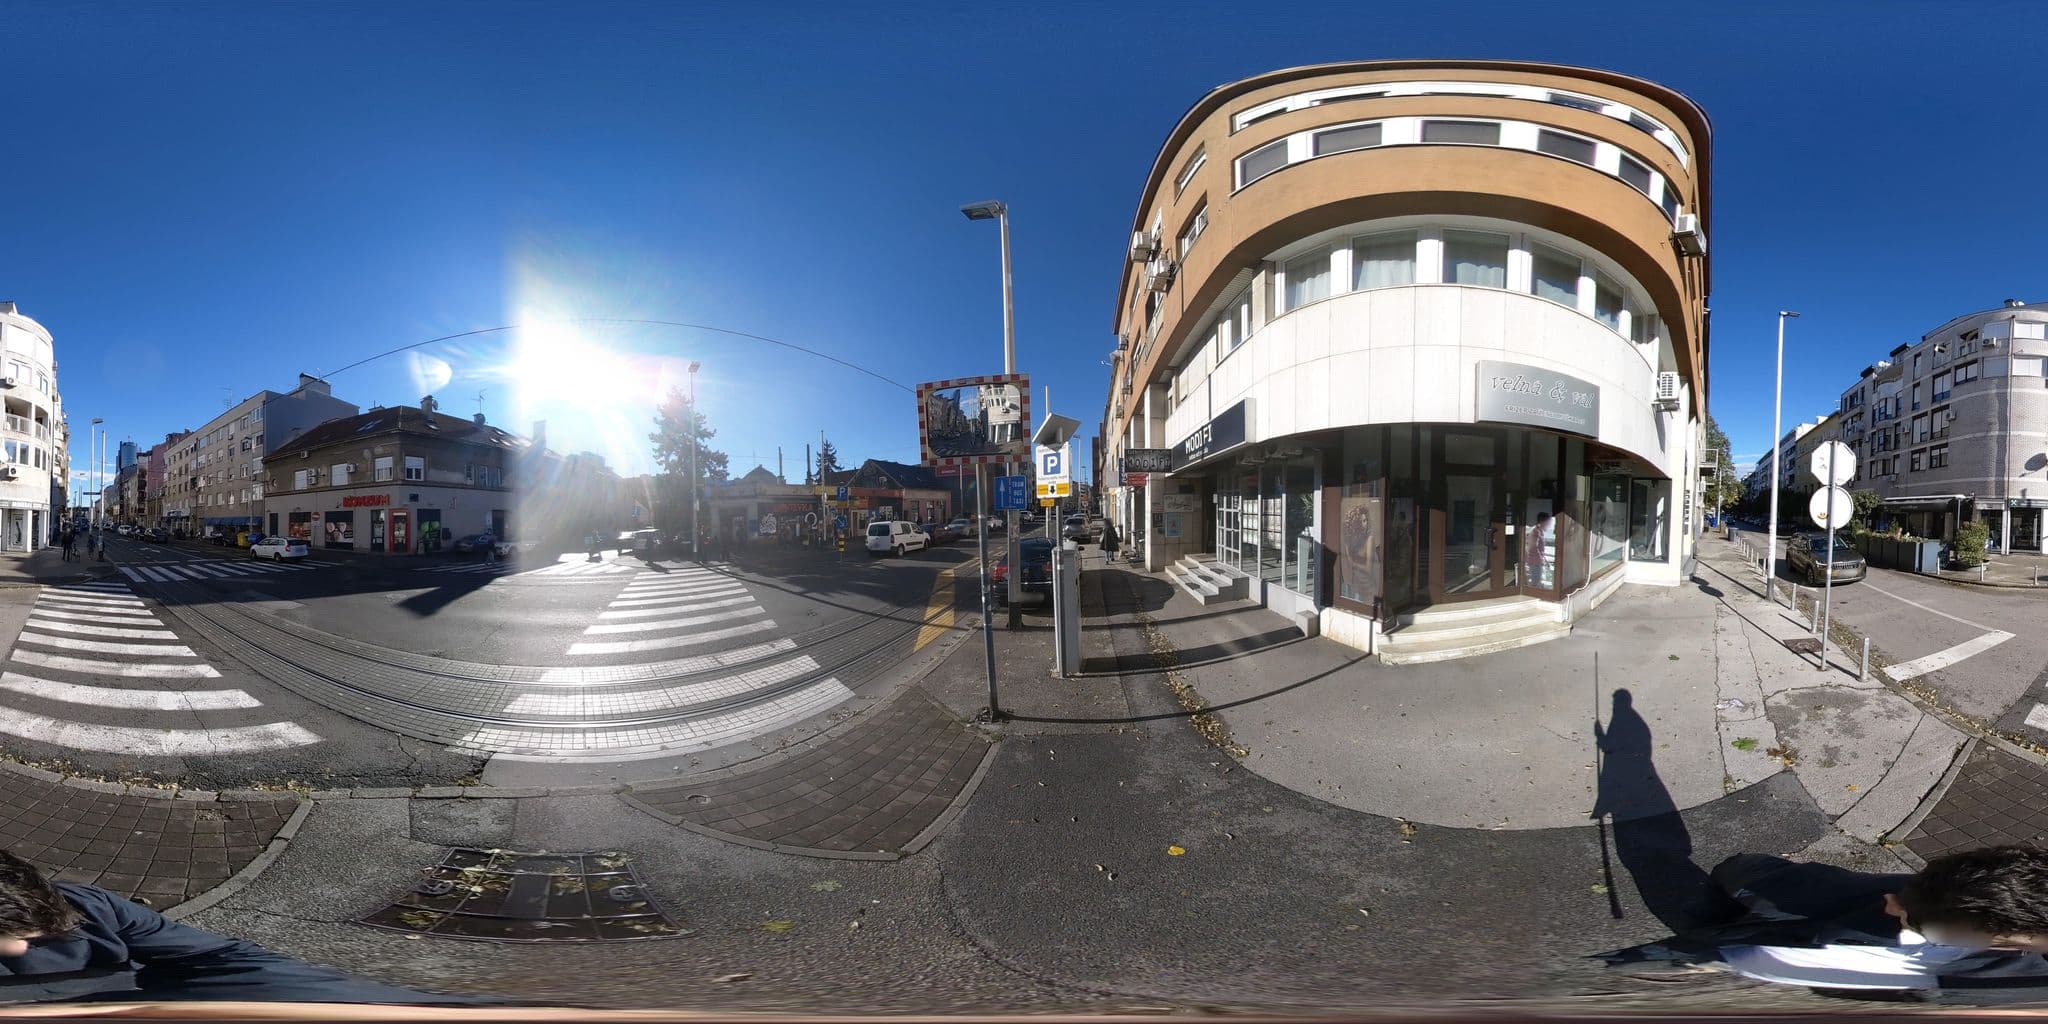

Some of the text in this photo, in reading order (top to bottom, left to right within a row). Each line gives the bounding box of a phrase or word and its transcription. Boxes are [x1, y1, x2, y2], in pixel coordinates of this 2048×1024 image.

[1490, 375, 1542, 396] velna
[1549, 380, 1568, 403] &
[1185, 423, 1212, 455] MODIFI
[1047, 456, 1058, 473] P
[1126, 456, 1170, 469] MODIFI
[343, 494, 390, 507] KONZUM
